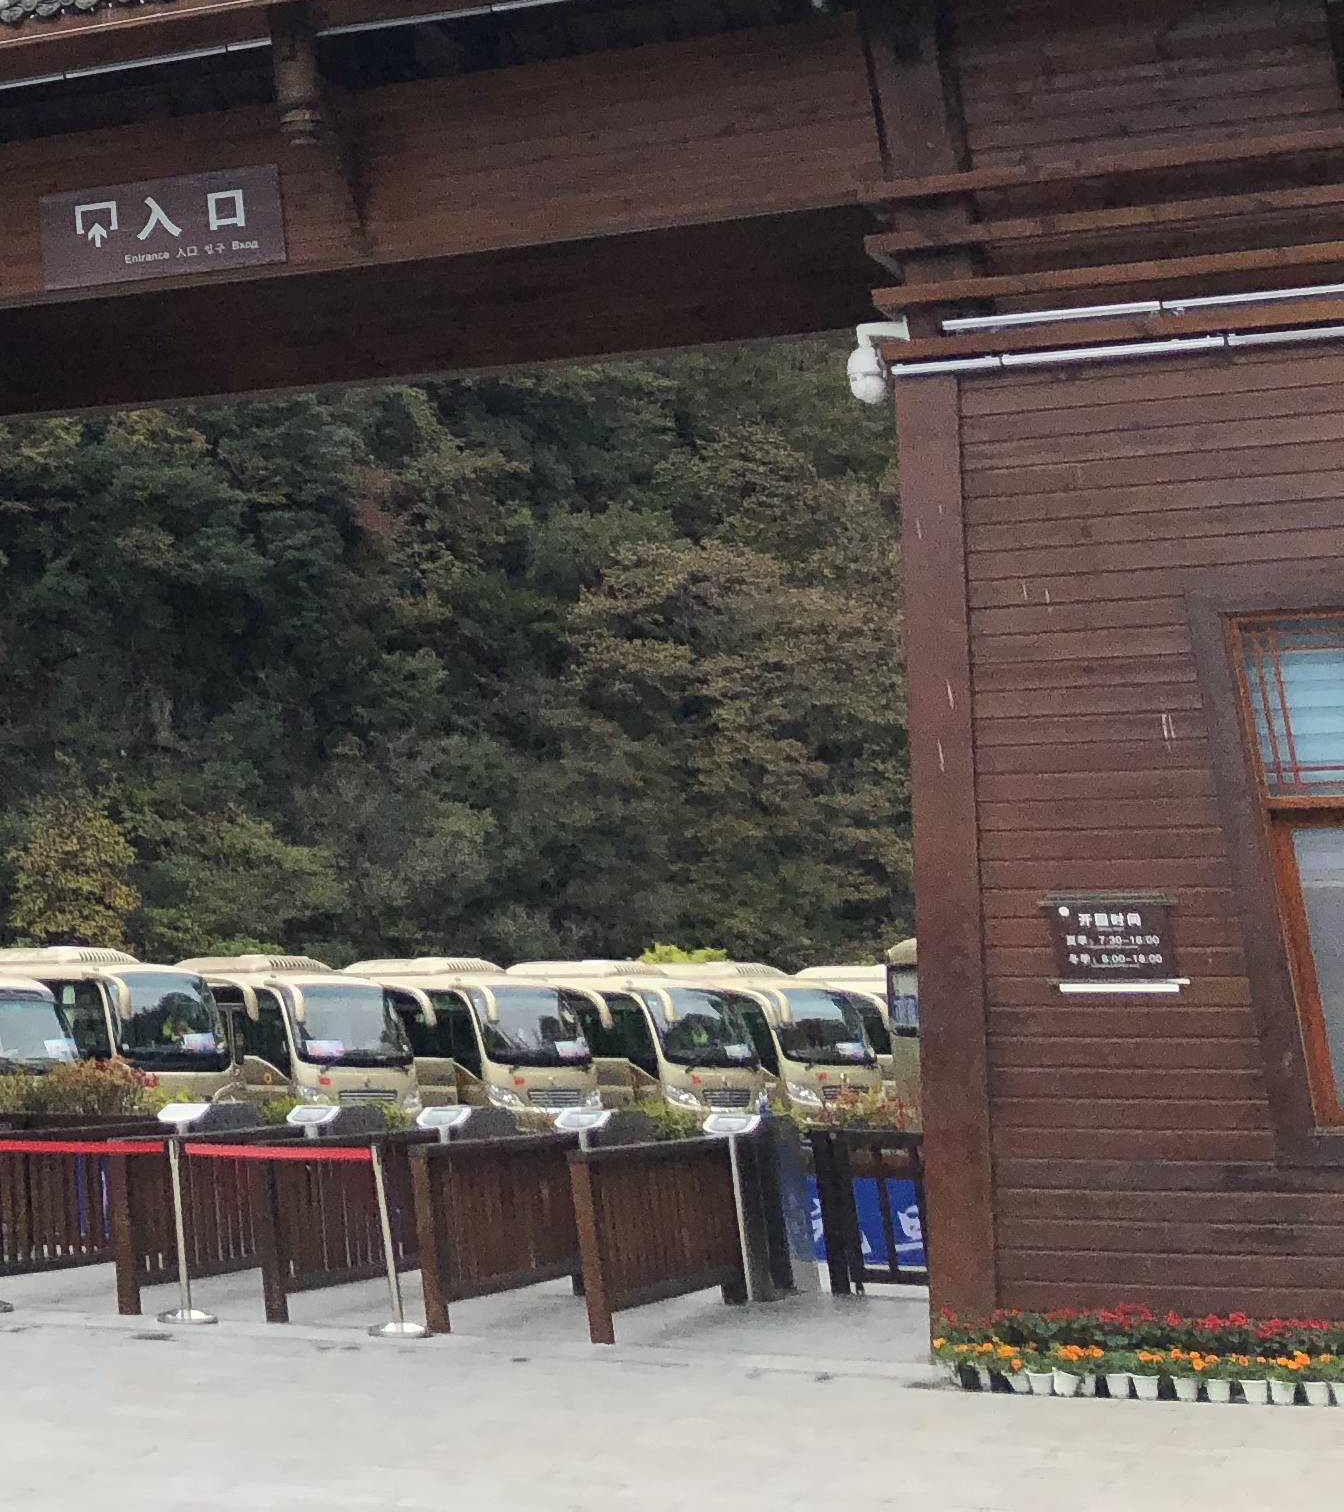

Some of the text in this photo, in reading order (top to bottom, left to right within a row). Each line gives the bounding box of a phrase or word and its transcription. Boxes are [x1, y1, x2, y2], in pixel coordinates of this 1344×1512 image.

[136, 188, 246, 241] 入口
[124, 251, 170, 264] Entrance
[176, 246, 198, 258] 入口
